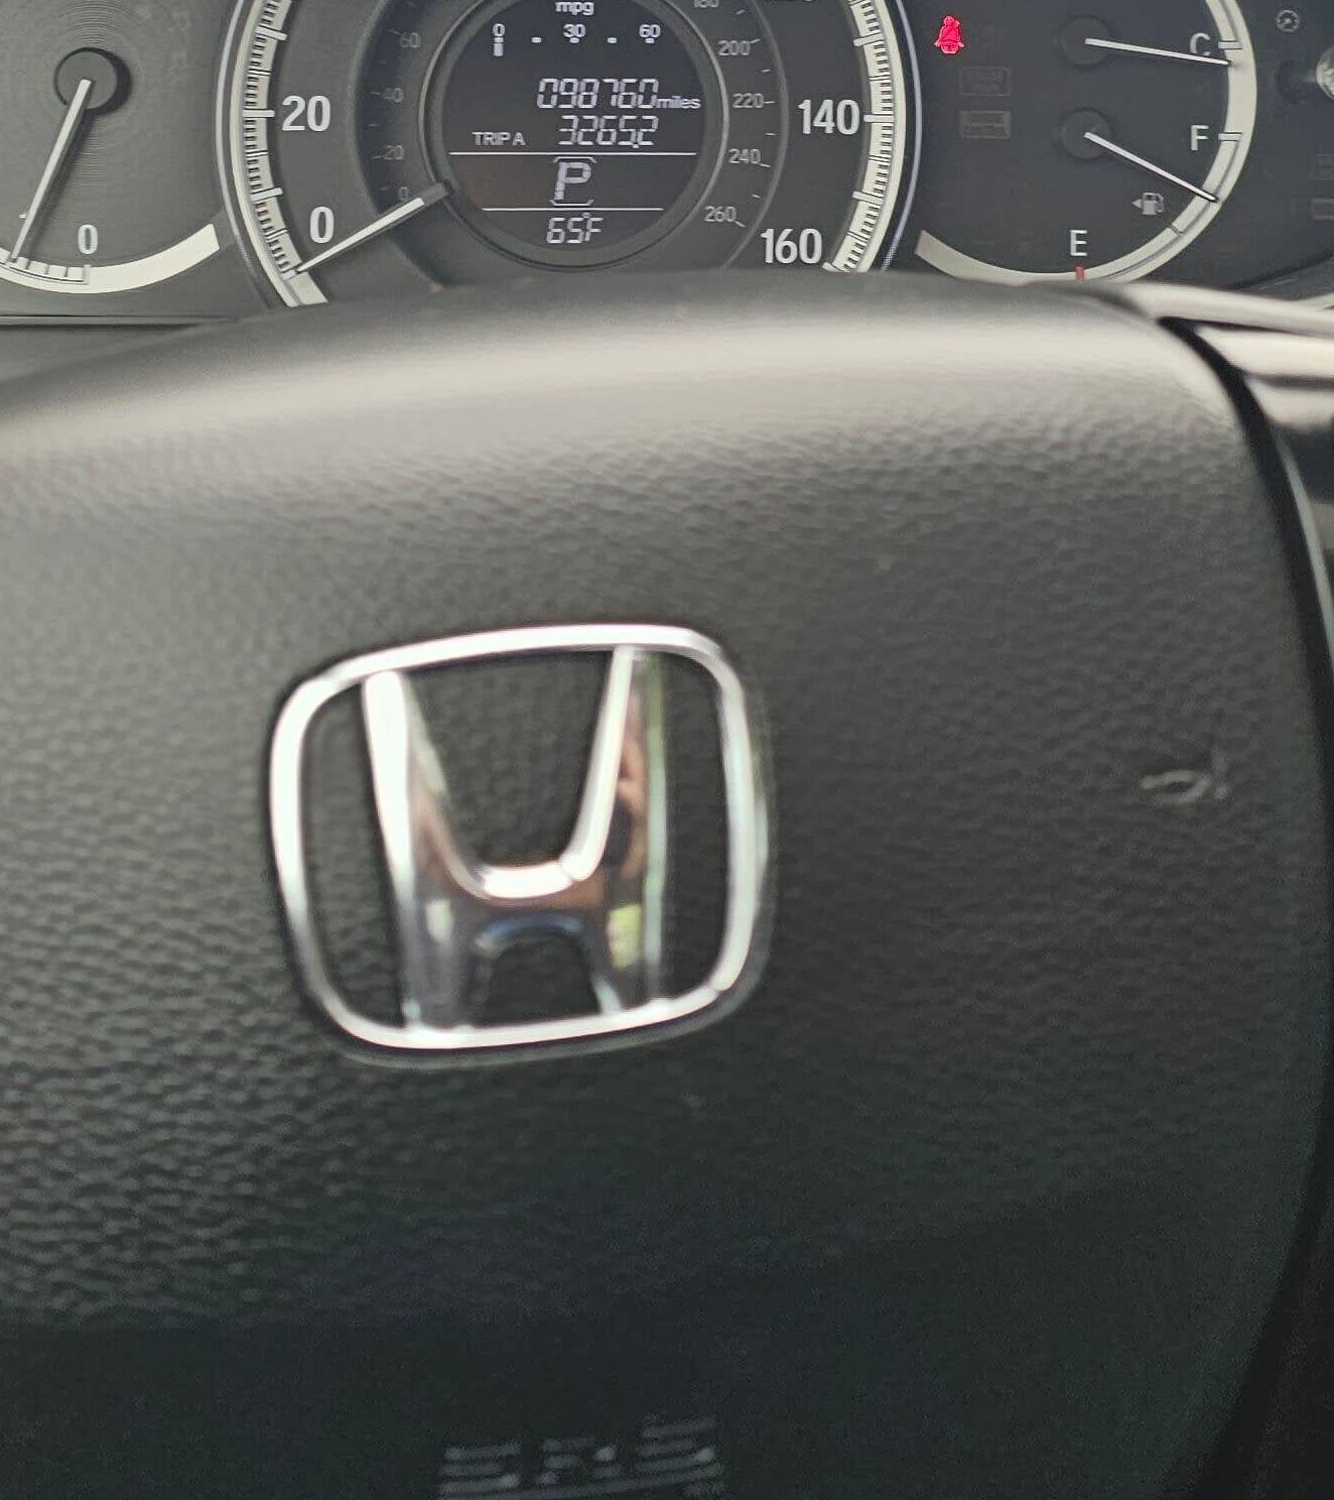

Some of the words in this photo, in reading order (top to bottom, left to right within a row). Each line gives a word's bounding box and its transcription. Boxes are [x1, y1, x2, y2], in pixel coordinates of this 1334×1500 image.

[555, 1, 595, 15] mpg
[399, 32, 420, 49] 60
[492, 23, 505, 37] 0
[563, 24, 586, 38] 30
[639, 24, 661, 38] 60
[718, 40, 750, 56] 200
[1189, 33, 1211, 58] C
[536, 78, 659, 109] 098760
[656, 94, 701, 110] miles
[732, 93, 764, 109] 220
[282, 95, 331, 132] 20
[798, 100, 860, 136] 140
[472, 131, 511, 146] TRIP
[512, 131, 526, 146] A
[1190, 125, 1209, 151] F
[729, 149, 761, 165] 240
[554, 162, 592, 201] P
[309, 206, 335, 243] 0
[704, 206, 736, 223] 260
[78, 224, 98, 254] 0
[761, 228, 821, 266] 160
[1070, 230, 1088, 256] E
